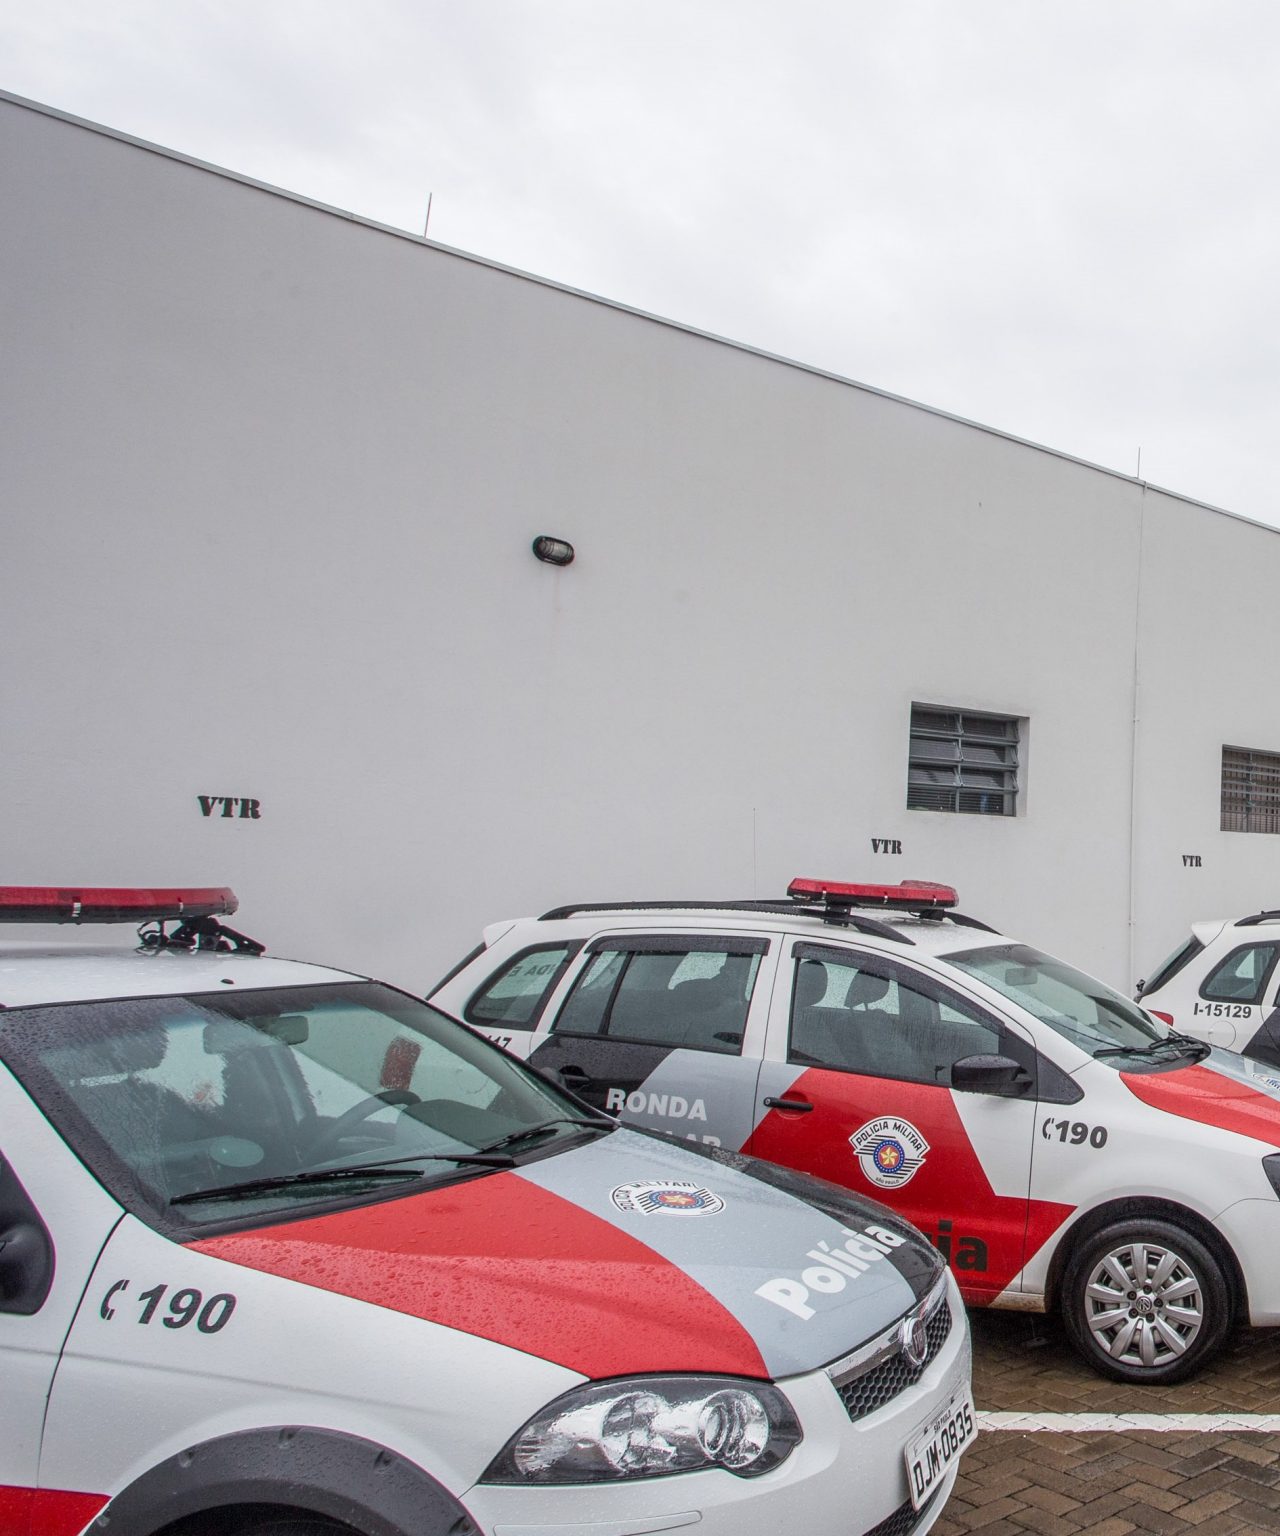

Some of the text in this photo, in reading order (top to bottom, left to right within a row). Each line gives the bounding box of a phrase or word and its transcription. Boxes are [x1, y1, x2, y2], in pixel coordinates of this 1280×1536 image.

[197, 795, 261, 819] VTR
[871, 838, 902, 854] VTR
[1182, 855, 1202, 867] VTR
[1193, 1003, 1252, 1019] I-15129
[606, 1088, 707, 1121] RONDA
[855, 1121, 923, 1151] POLICIA MILITAR
[1055, 1120, 1108, 1149] 190
[754, 1225, 907, 1321] Polícia
[138, 1284, 237, 1334] 190
